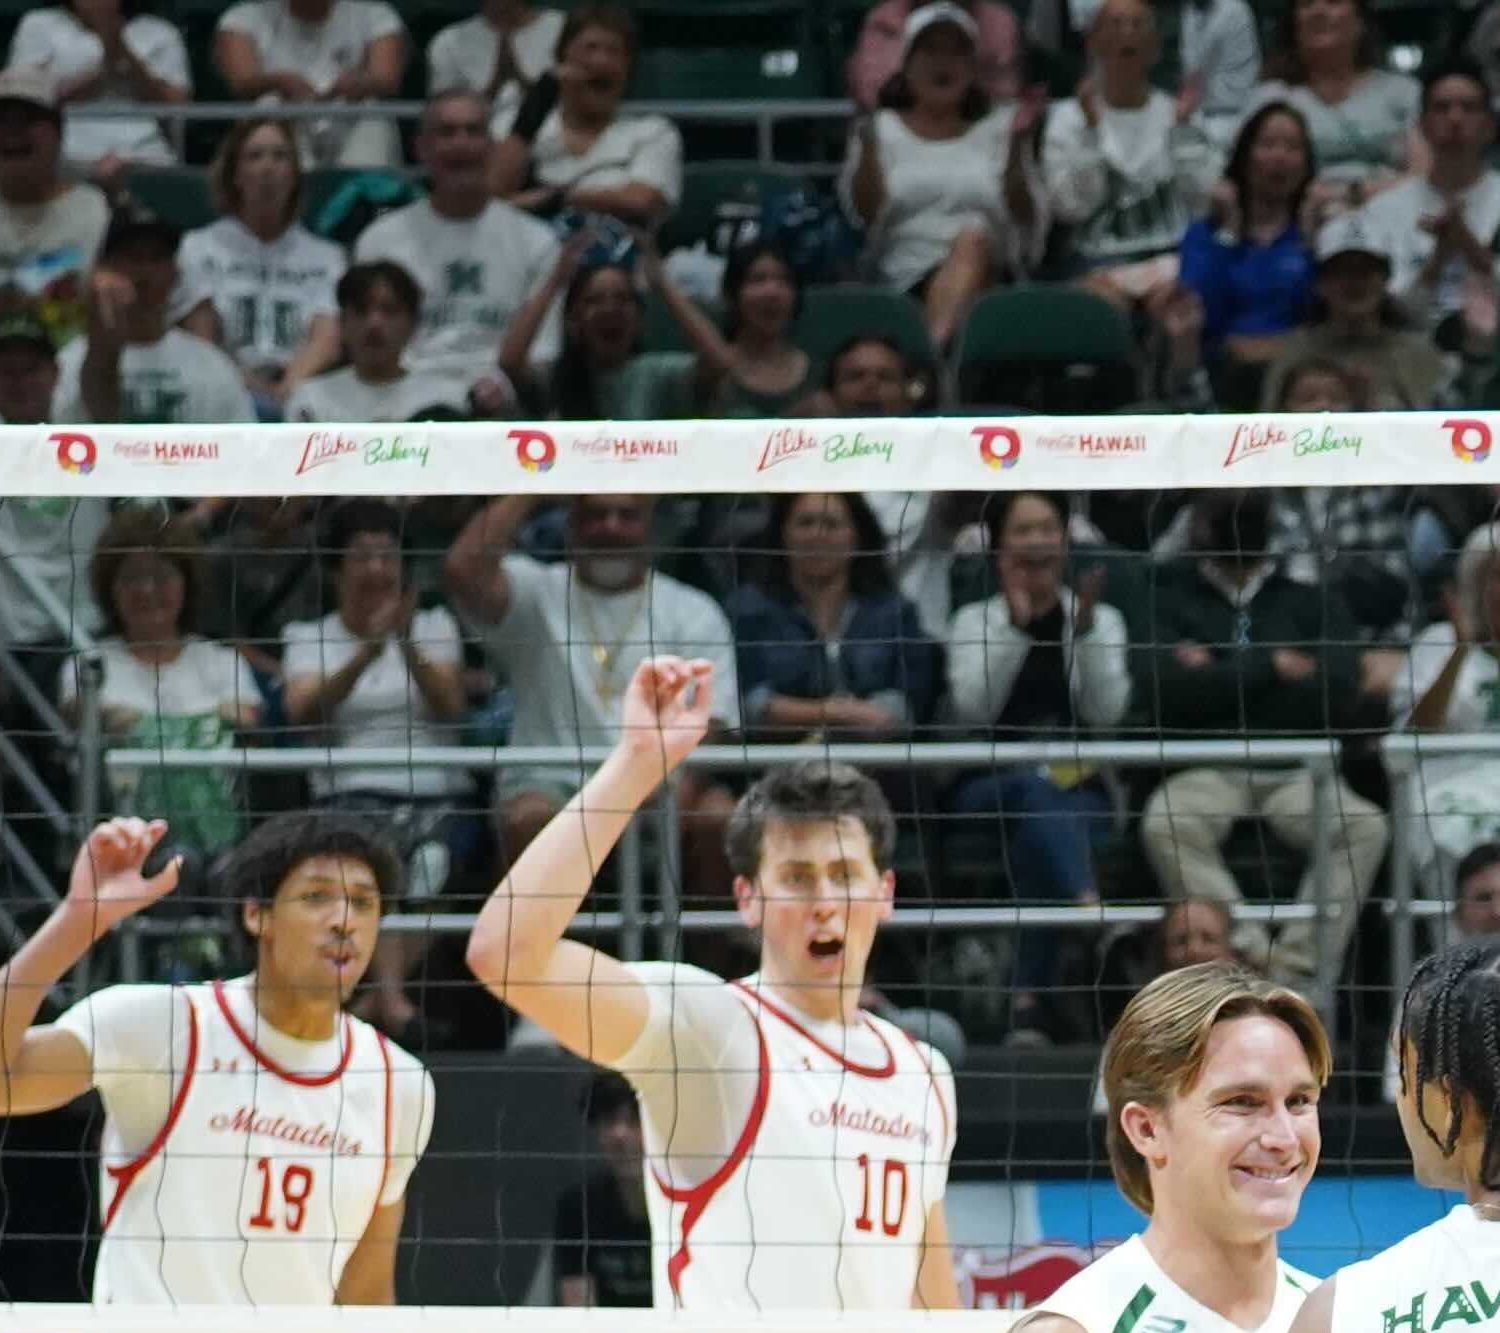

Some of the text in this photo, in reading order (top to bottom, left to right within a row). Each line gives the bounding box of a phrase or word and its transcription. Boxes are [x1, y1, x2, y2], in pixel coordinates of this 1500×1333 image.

[154, 441, 219, 459] HAWAII
[363, 436, 431, 468] Bakery
[613, 438, 678, 456] HAWAII
[823, 433, 894, 464] Bakery
[1079, 434, 1146, 451] HAWAII
[1292, 426, 1362, 457] Bakery
[208, 1104, 364, 1157] Matadors
[247, 1156, 315, 1234] 19
[854, 1152, 910, 1238] 10
